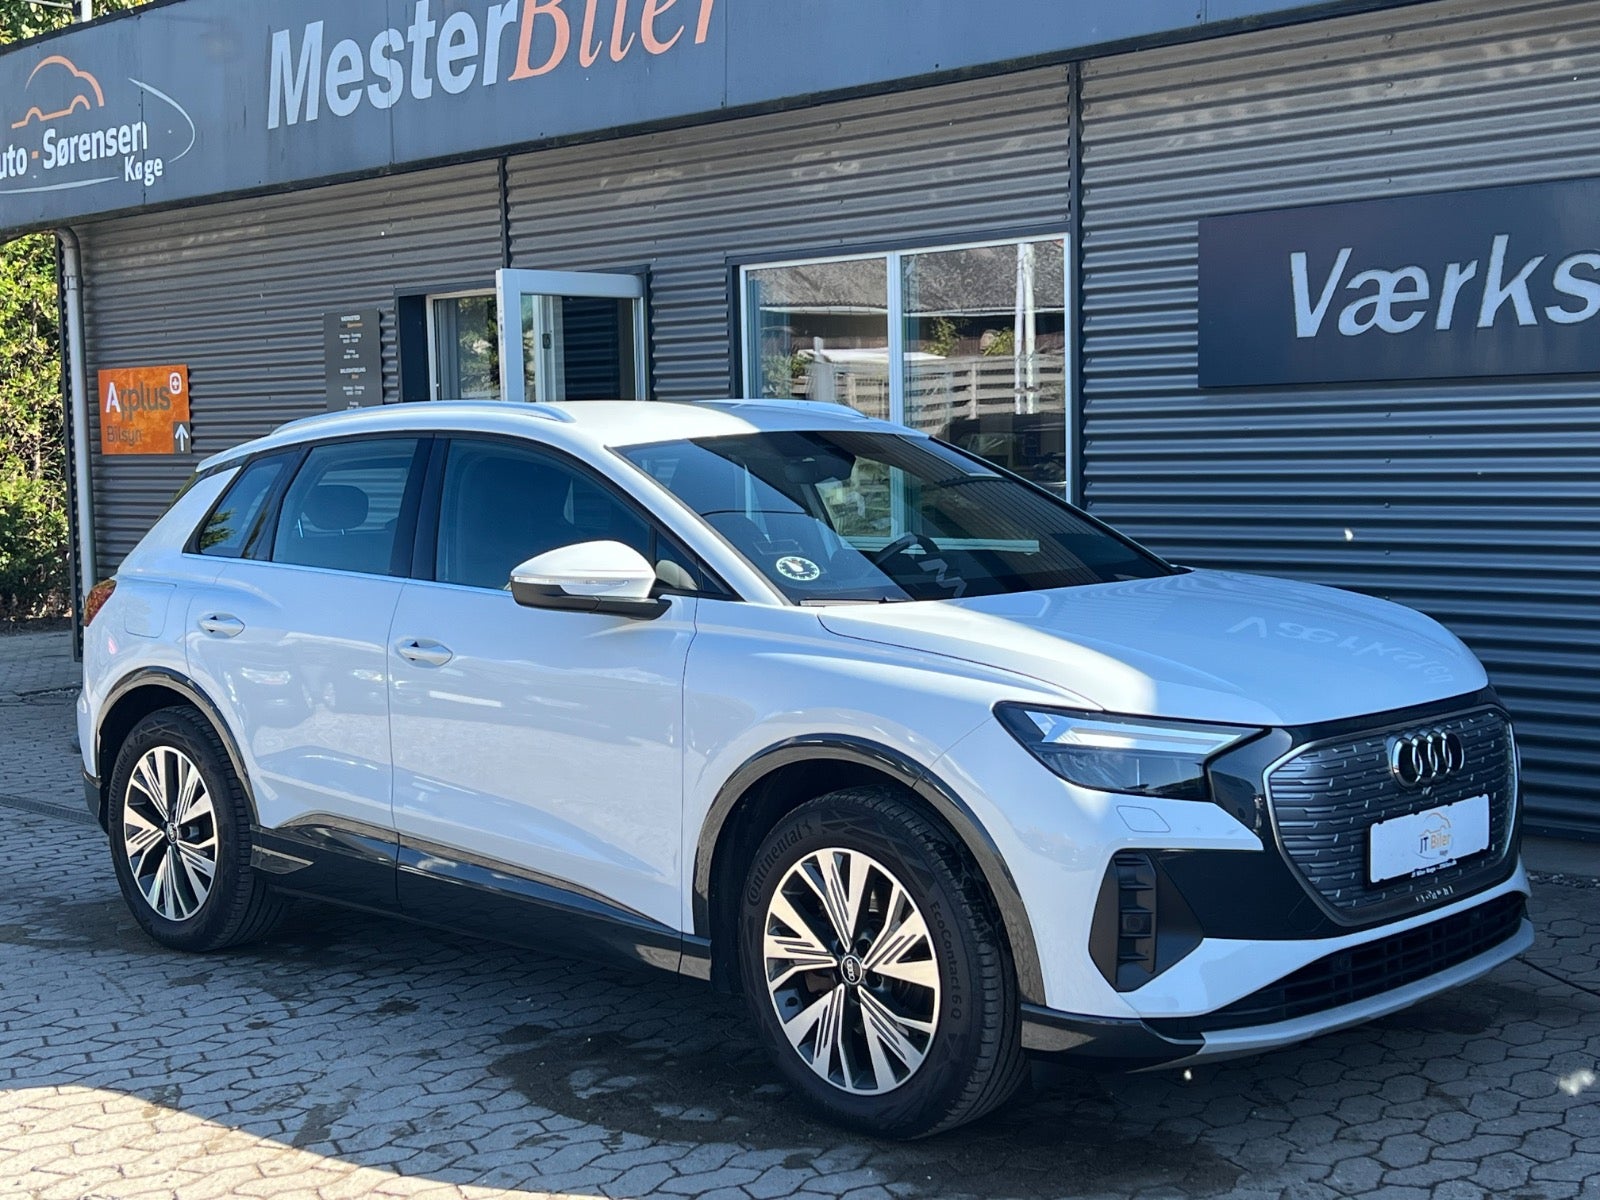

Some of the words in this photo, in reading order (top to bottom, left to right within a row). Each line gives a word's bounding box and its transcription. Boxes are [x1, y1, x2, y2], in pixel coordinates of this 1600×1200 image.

[43, 121, 148, 169] Sørensen
[124, 155, 163, 186] Køge
[1290, 234, 1600, 338] Værks
[747, 824, 803, 906] Continental
[929, 900, 959, 992] EcoContact
